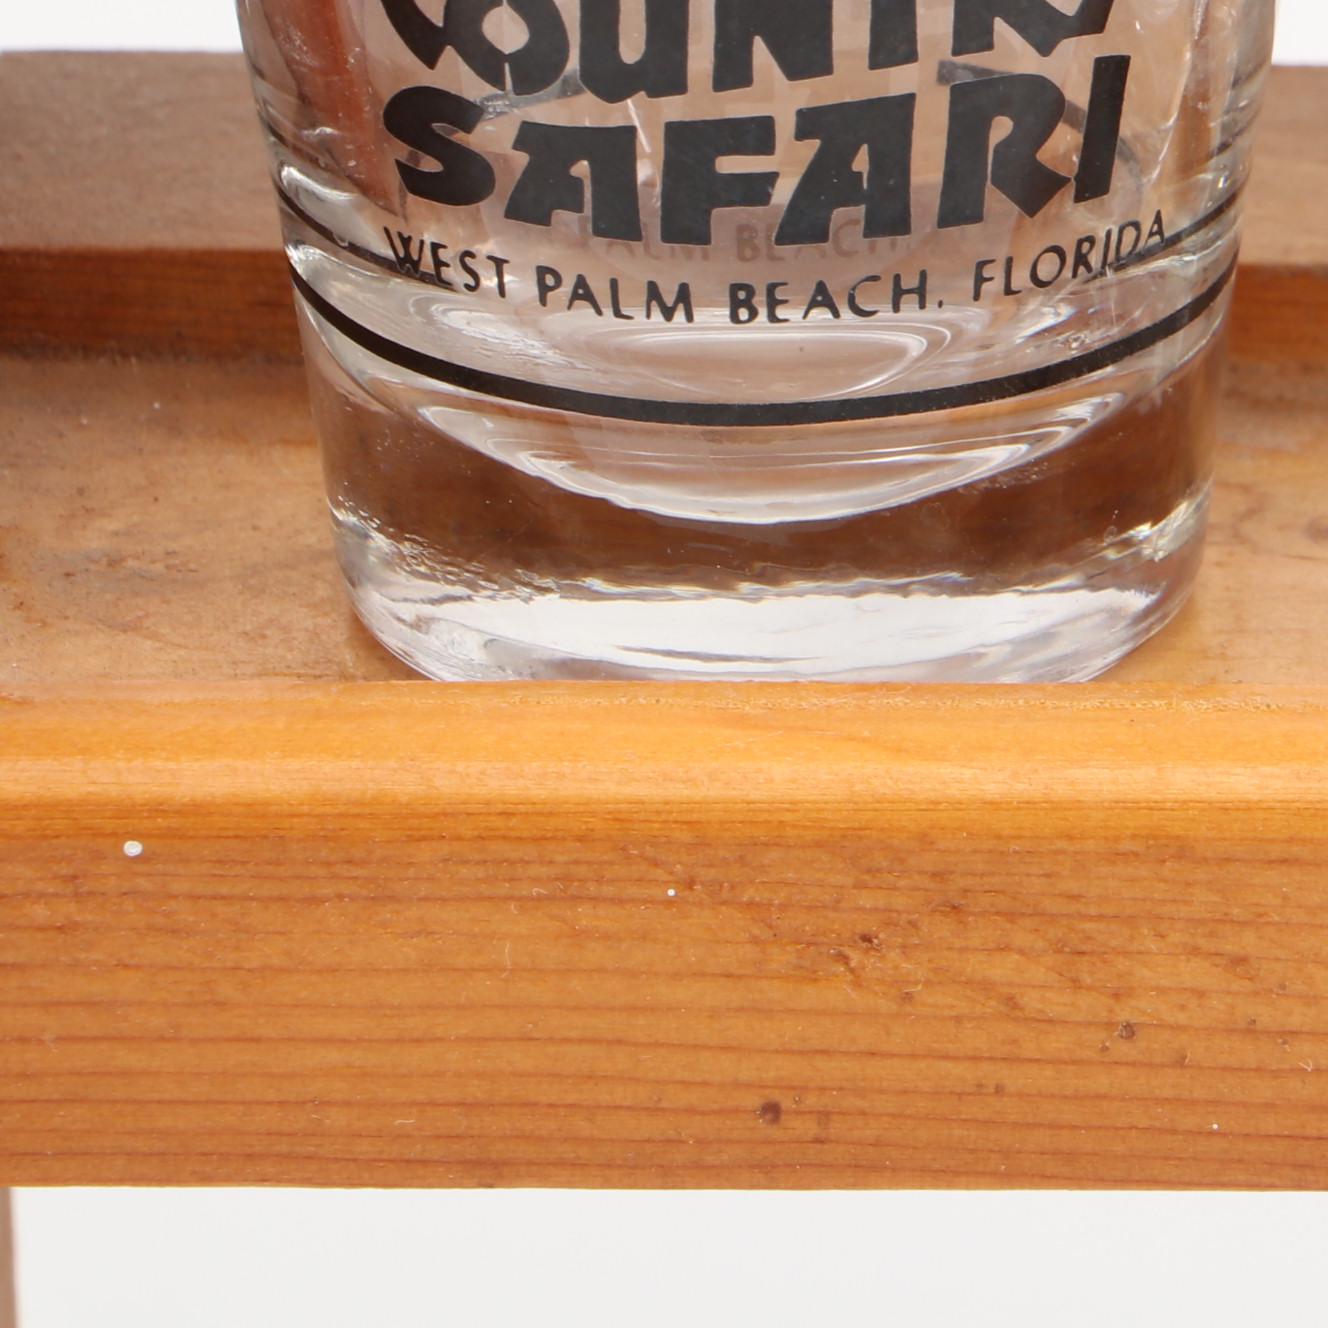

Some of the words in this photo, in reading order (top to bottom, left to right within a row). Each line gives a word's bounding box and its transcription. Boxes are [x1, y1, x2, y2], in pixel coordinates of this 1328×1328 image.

[382, 54, 1132, 247] SAFARI
[383, 225, 511, 301] WEST
[536, 271, 695, 325] PALM
[971, 209, 1167, 303] FLORIDA
